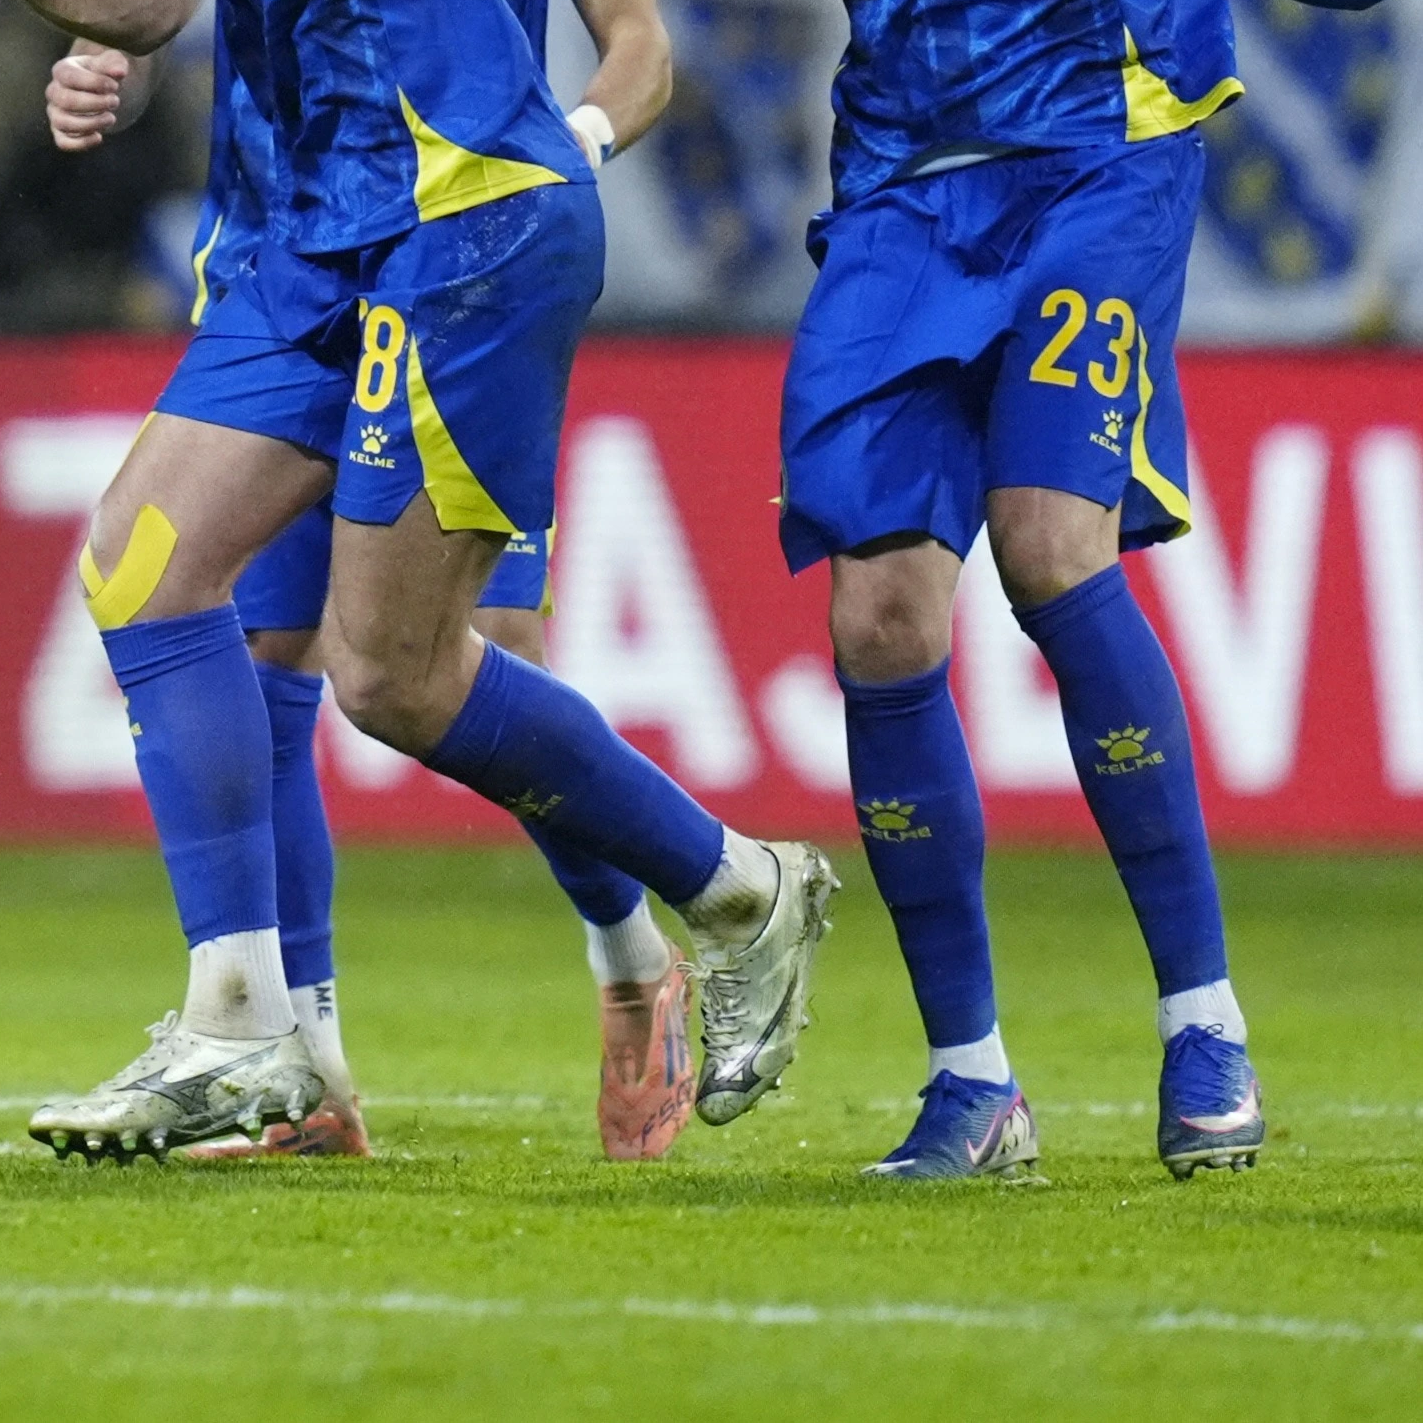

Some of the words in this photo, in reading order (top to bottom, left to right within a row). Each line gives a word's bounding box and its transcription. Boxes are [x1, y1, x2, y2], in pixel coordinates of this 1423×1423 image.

[352, 298, 406, 413] 8
[1029, 288, 1136, 398] 23
[1089, 432, 1123, 457] KELME
[348, 450, 396, 469] KELME
[503, 541, 537, 555] ELME
[1095, 751, 1166, 776] KELME
